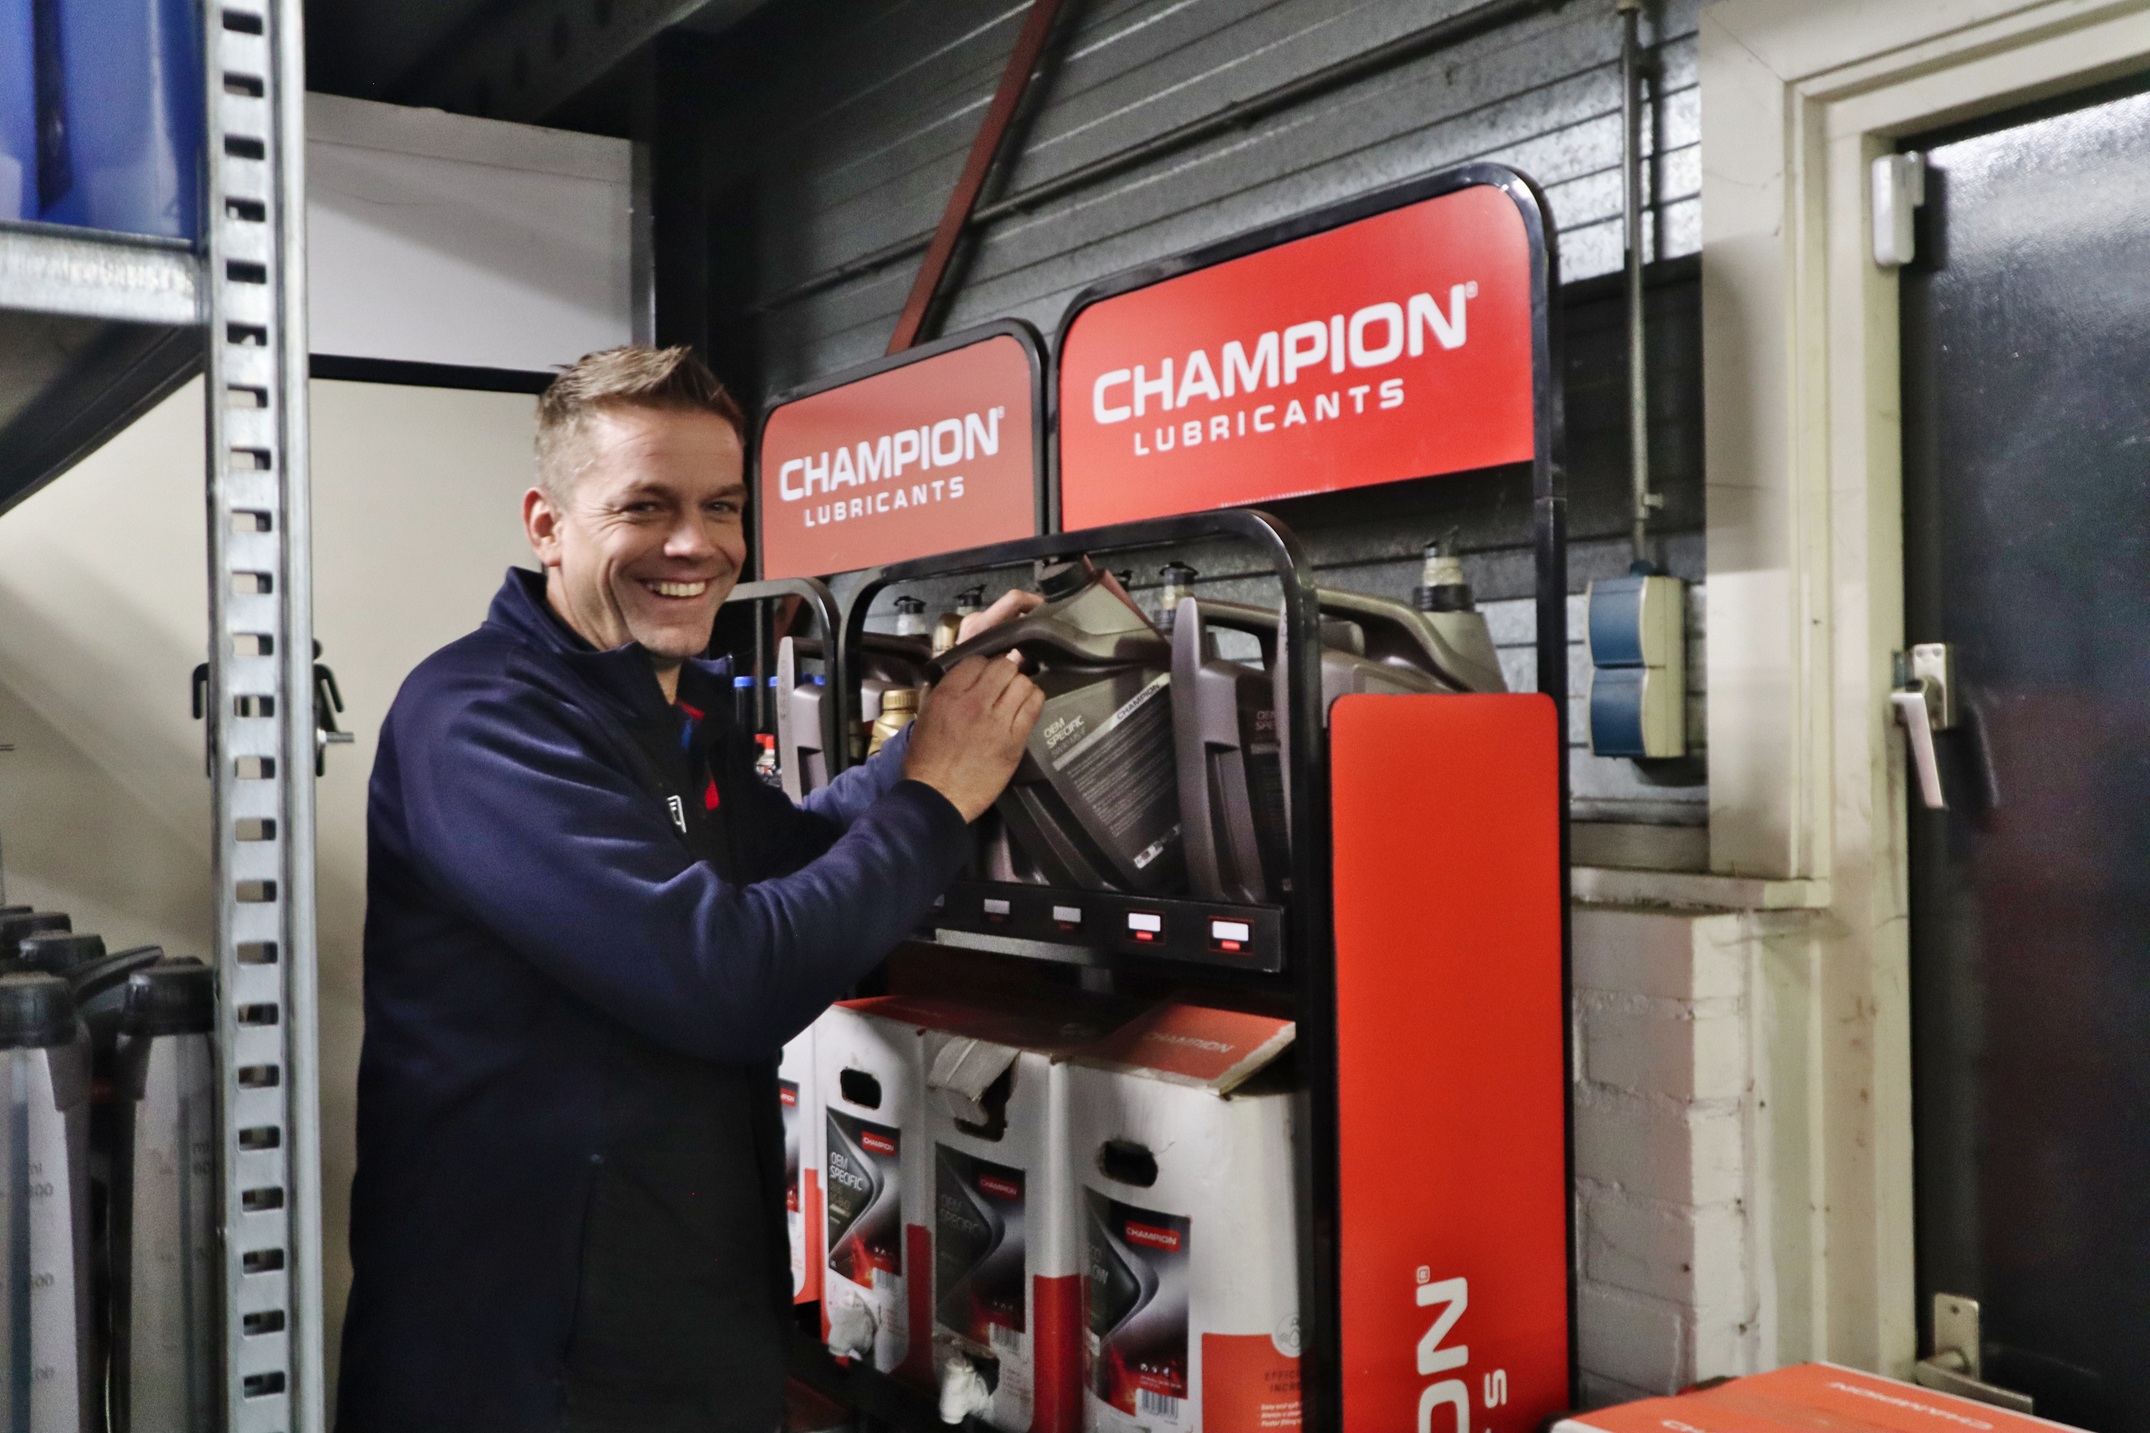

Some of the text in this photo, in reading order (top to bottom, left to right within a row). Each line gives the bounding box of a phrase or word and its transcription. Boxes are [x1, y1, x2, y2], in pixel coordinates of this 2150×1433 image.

[1134, 378, 1405, 456] LUBRICANTS
[804, 476, 964, 527] LUBRICANTS
[1116, 682, 1160, 720] CHAMPION
[1043, 717, 1066, 739] OEM
[1046, 715, 1085, 749] SPECIFIC
[1142, 1030, 1236, 1054] CHAMPION
[863, 1136, 894, 1151] CHAMPION
[830, 1151, 848, 1170] OEM
[829, 1165, 863, 1191] SPECIFIC
[980, 1179, 1017, 1195] CHAMPION
[1125, 1226, 1178, 1245] CHAMPION
